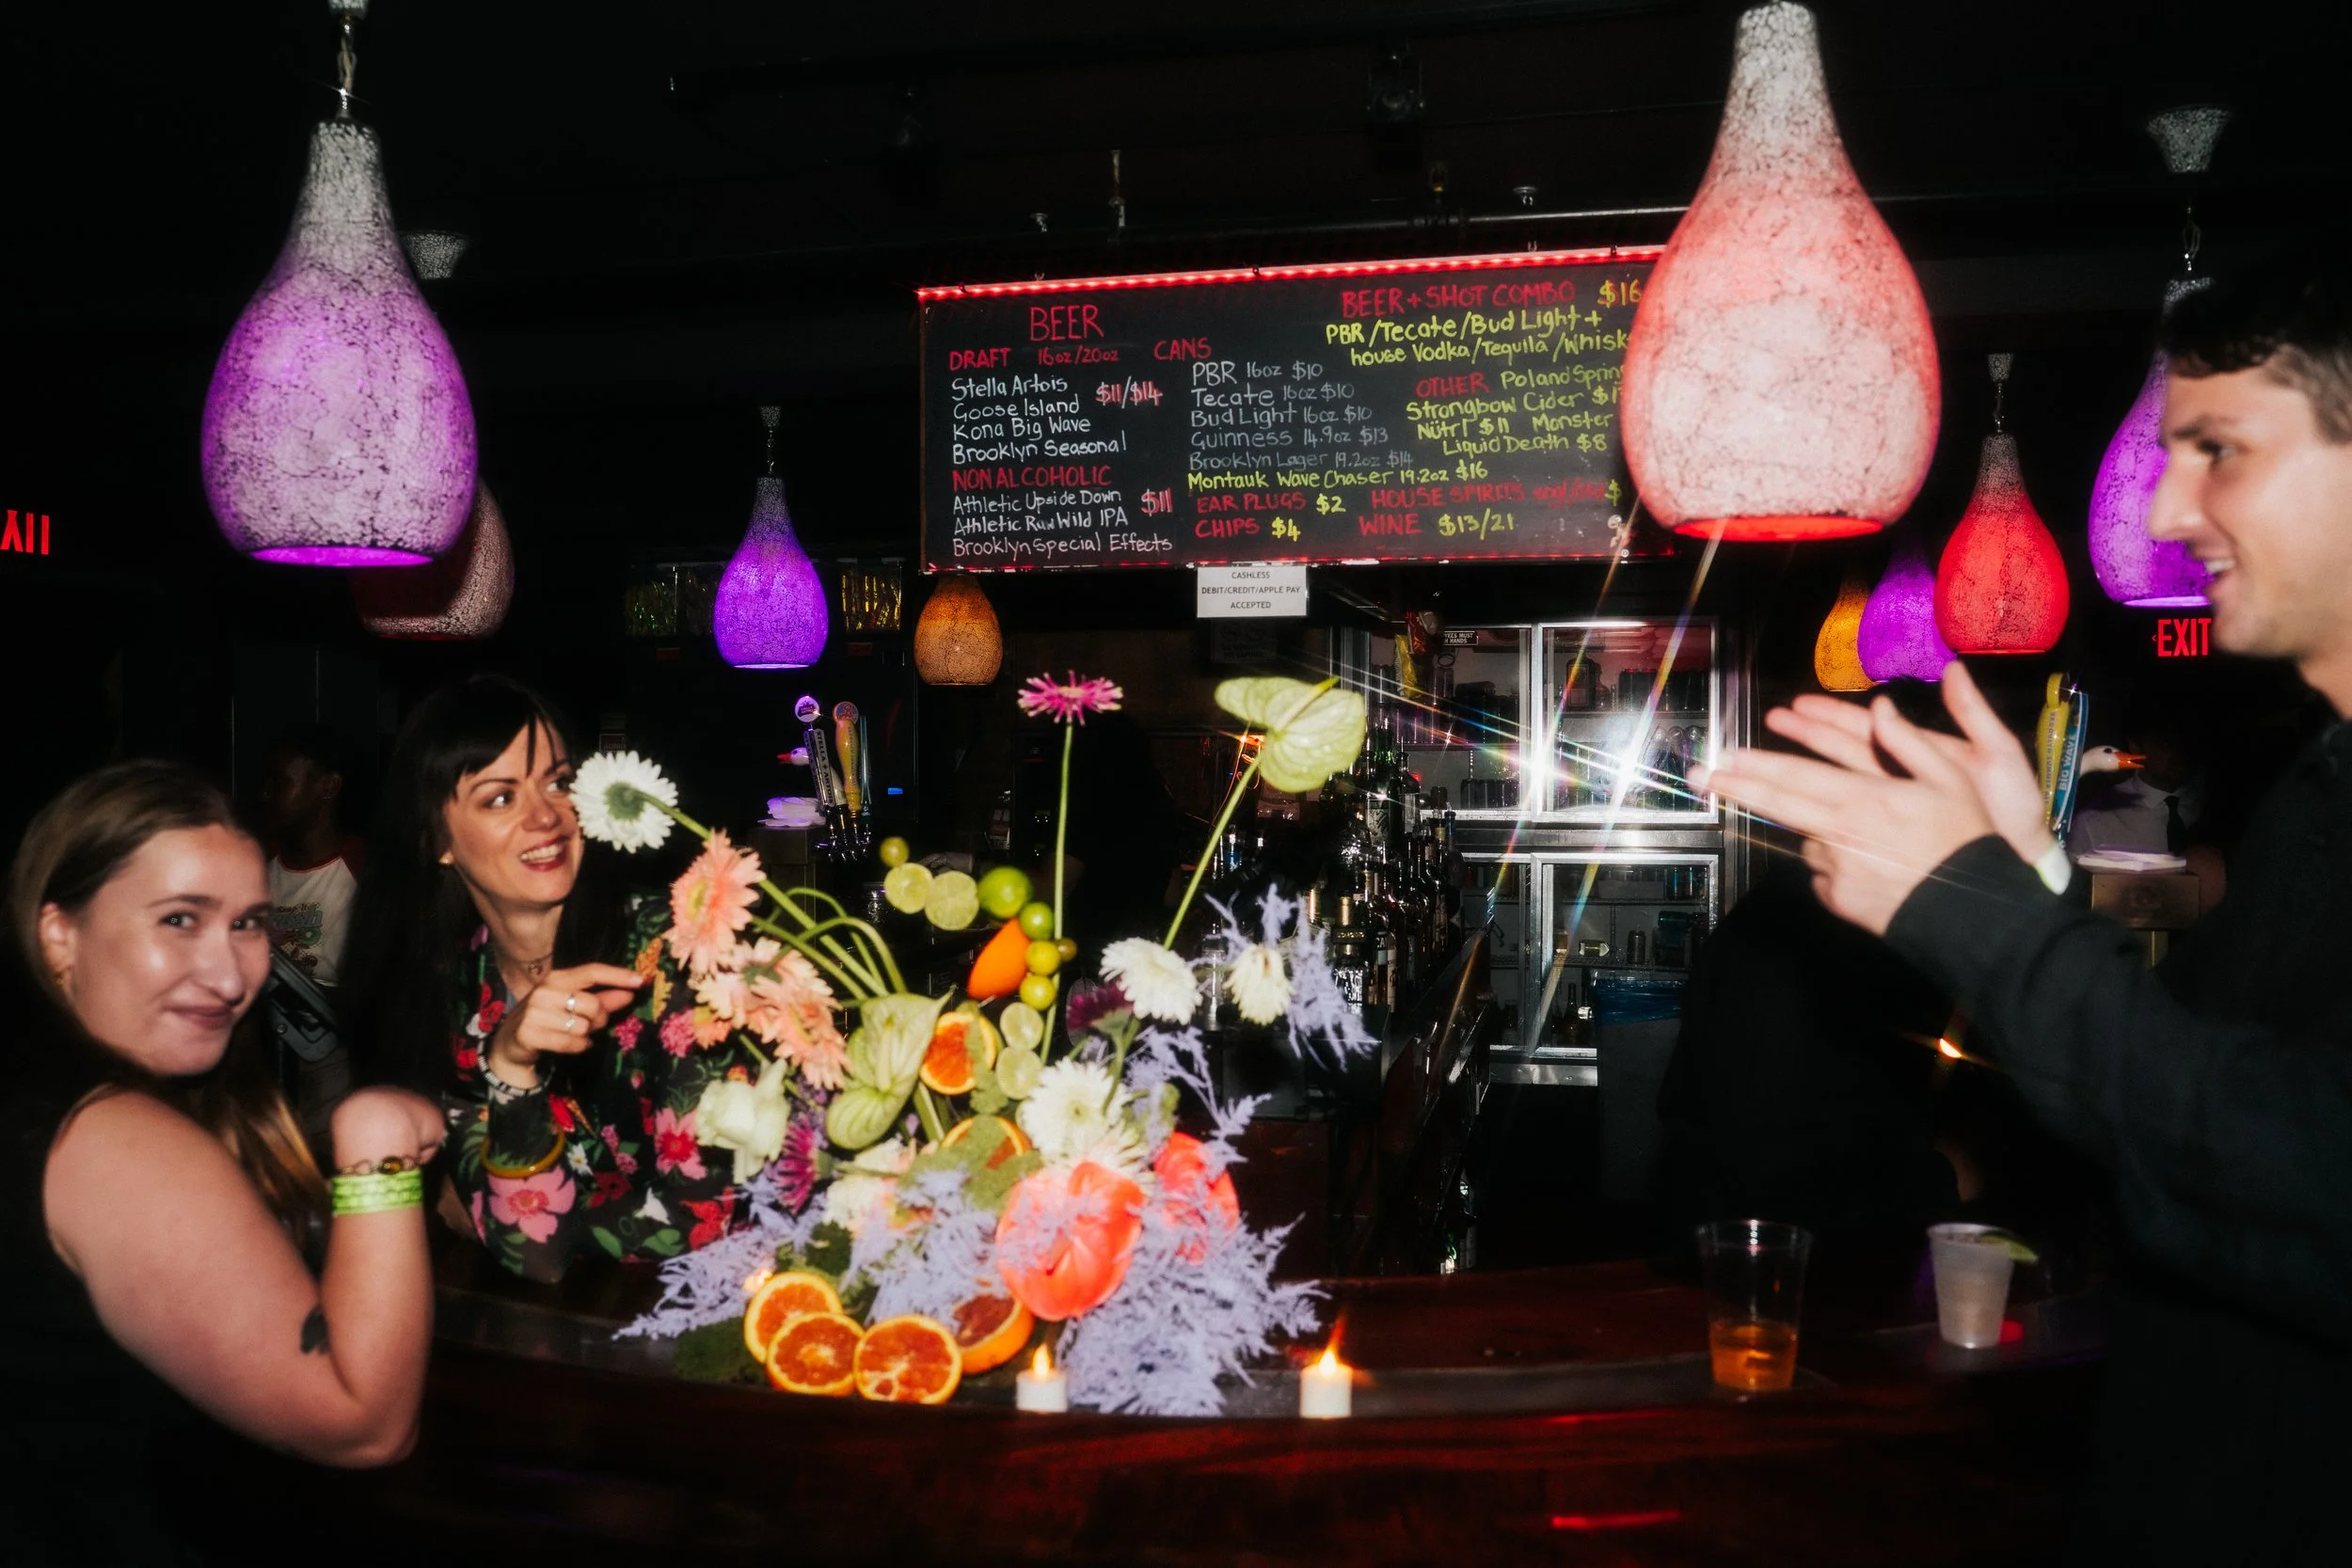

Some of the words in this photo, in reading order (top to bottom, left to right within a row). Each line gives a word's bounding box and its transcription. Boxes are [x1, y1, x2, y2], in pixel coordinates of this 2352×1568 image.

[1492, 280, 1576, 308] COMBO
[1597, 279, 1643, 309] $16
[1030, 305, 1104, 341] BEER
[1521, 305, 1581, 338] Light
[949, 348, 1011, 371] DRAFT
[1039, 345, 1120, 365] 16oz/20oz
[1153, 337, 1212, 361] CANS
[1351, 347, 1406, 367] house
[1192, 361, 1237, 386] PBR
[1247, 363, 1281, 378] 16oz
[1293, 361, 1323, 381] $10
[1416, 372, 1490, 399] OTHER
[1501, 365, 1569, 389] Poland
[952, 377, 1007, 402] Stella
[1011, 373, 1068, 397] Artois
[1096, 376, 1164, 409] $11/$14
[1191, 383, 1274, 407] Tecate
[1283, 386, 1317, 400] 16oz
[1321, 382, 1354, 402] $10
[954, 404, 1019, 420] Goose
[1025, 393, 1079, 416] Island
[1191, 408, 1233, 427] Bud
[1239, 403, 1296, 429] Light
[1303, 406, 1339, 423] 16oz
[1343, 404, 1372, 424] $10
[1406, 397, 1517, 421] Strongbow
[1523, 390, 1584, 411] Cider
[1592, 385, 1623, 405] $1
[954, 423, 1004, 441] Kona
[1011, 418, 1042, 440] Big
[1049, 416, 1091, 434] Wave
[1479, 418, 1510, 436] $11
[1532, 411, 1613, 433] Monster
[953, 442, 1038, 465] Brooklyn
[1044, 430, 1127, 456] Seasonal
[1191, 427, 1293, 450] Guinness
[1303, 427, 1351, 448] 14.9oz
[1359, 426, 1389, 446] $13
[1443, 436, 1501, 459] Liquid
[1504, 435, 1568, 453] Death
[1576, 433, 1607, 452] $8
[1189, 449, 1271, 470] Brooklyn
[1277, 453, 1328, 470] Lager
[1335, 452, 1380, 467] 19.2oz
[1388, 450, 1413, 468] $14
[1187, 470, 1269, 492] Montauk
[1277, 470, 1320, 487] Wave
[1324, 470, 1393, 488] Chaser
[1400, 468, 1449, 484] 19.2oz
[1455, 459, 1488, 481] $16
[953, 495, 1022, 515] Athletic
[1026, 490, 1076, 514] Upside
[1080, 489, 1121, 504] Down
[1141, 487, 1173, 516] $11
[1197, 495, 1238, 515] EAR
[1244, 492, 1307, 511] PLUGS
[1316, 493, 1346, 515] $2
[1371, 486, 1446, 509] HOUSE
[1450, 483, 1526, 503] SPIRITS
[954, 515, 1022, 535] Athletic
[1026, 516, 1055, 531] Run
[1057, 510, 1092, 529] Wild
[1100, 506, 1129, 527] IPA
[1195, 517, 1260, 539] CHIPS
[1271, 516, 1301, 542] $4
[1359, 514, 1422, 536] WINE
[1438, 508, 1514, 540] $13/21
[953, 536, 1031, 562] Brooklyn
[1033, 531, 1101, 559] Special
[1110, 531, 1172, 553] Effects
[2157, 618, 2213, 657] EXIT
